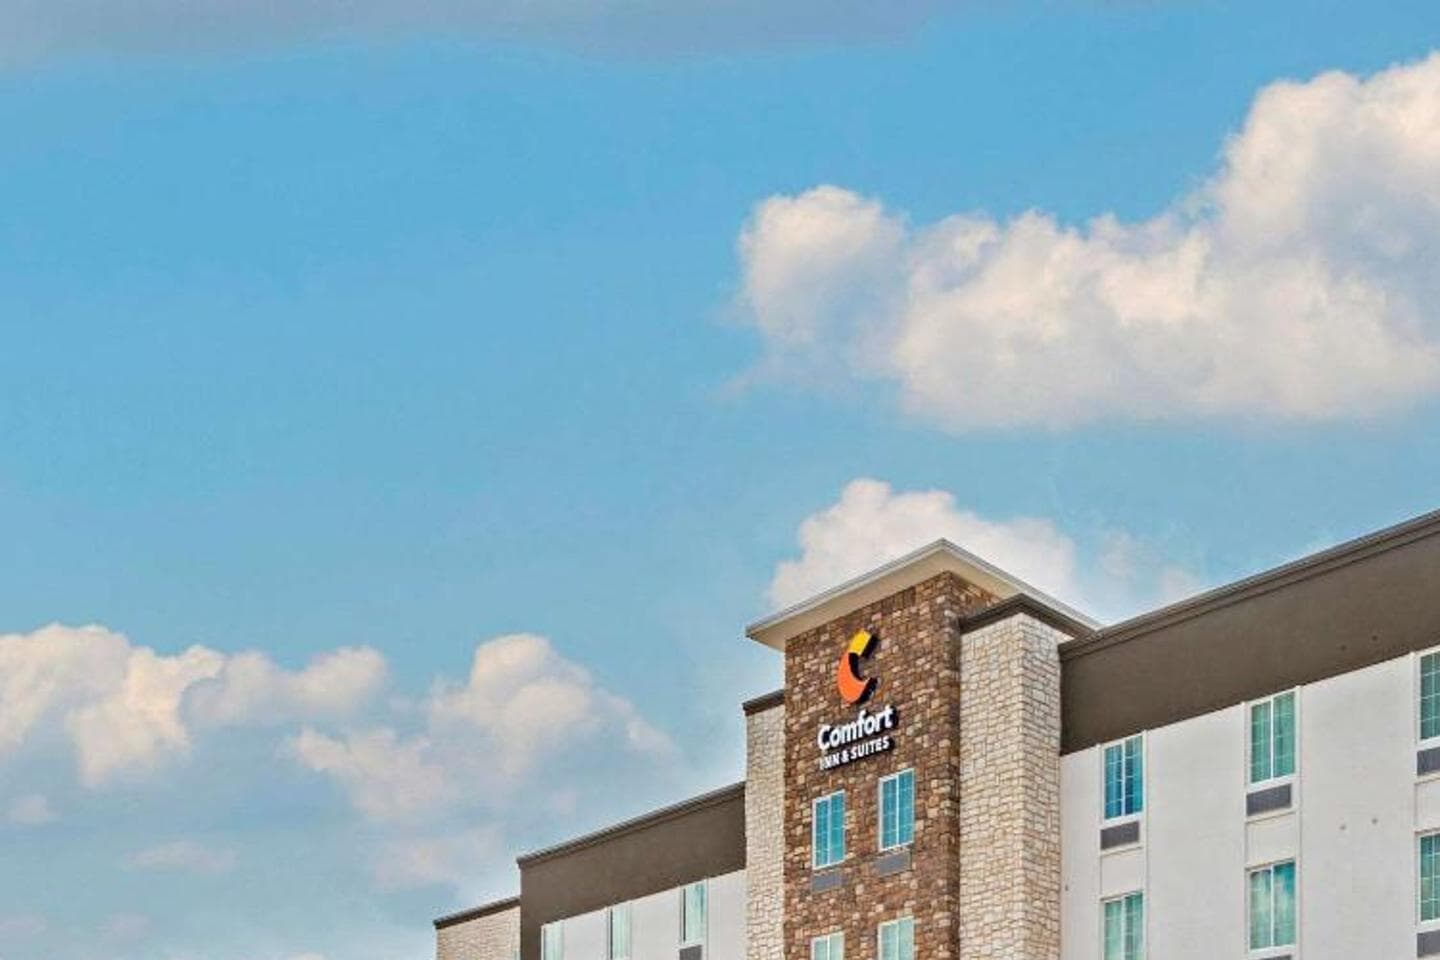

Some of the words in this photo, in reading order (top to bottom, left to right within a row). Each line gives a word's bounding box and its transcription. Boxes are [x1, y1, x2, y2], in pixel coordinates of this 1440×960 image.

[817, 704, 893, 751] Comfort
[819, 752, 841, 771] INN
[841, 749, 850, 763] &
[850, 735, 890, 760] SUITES
